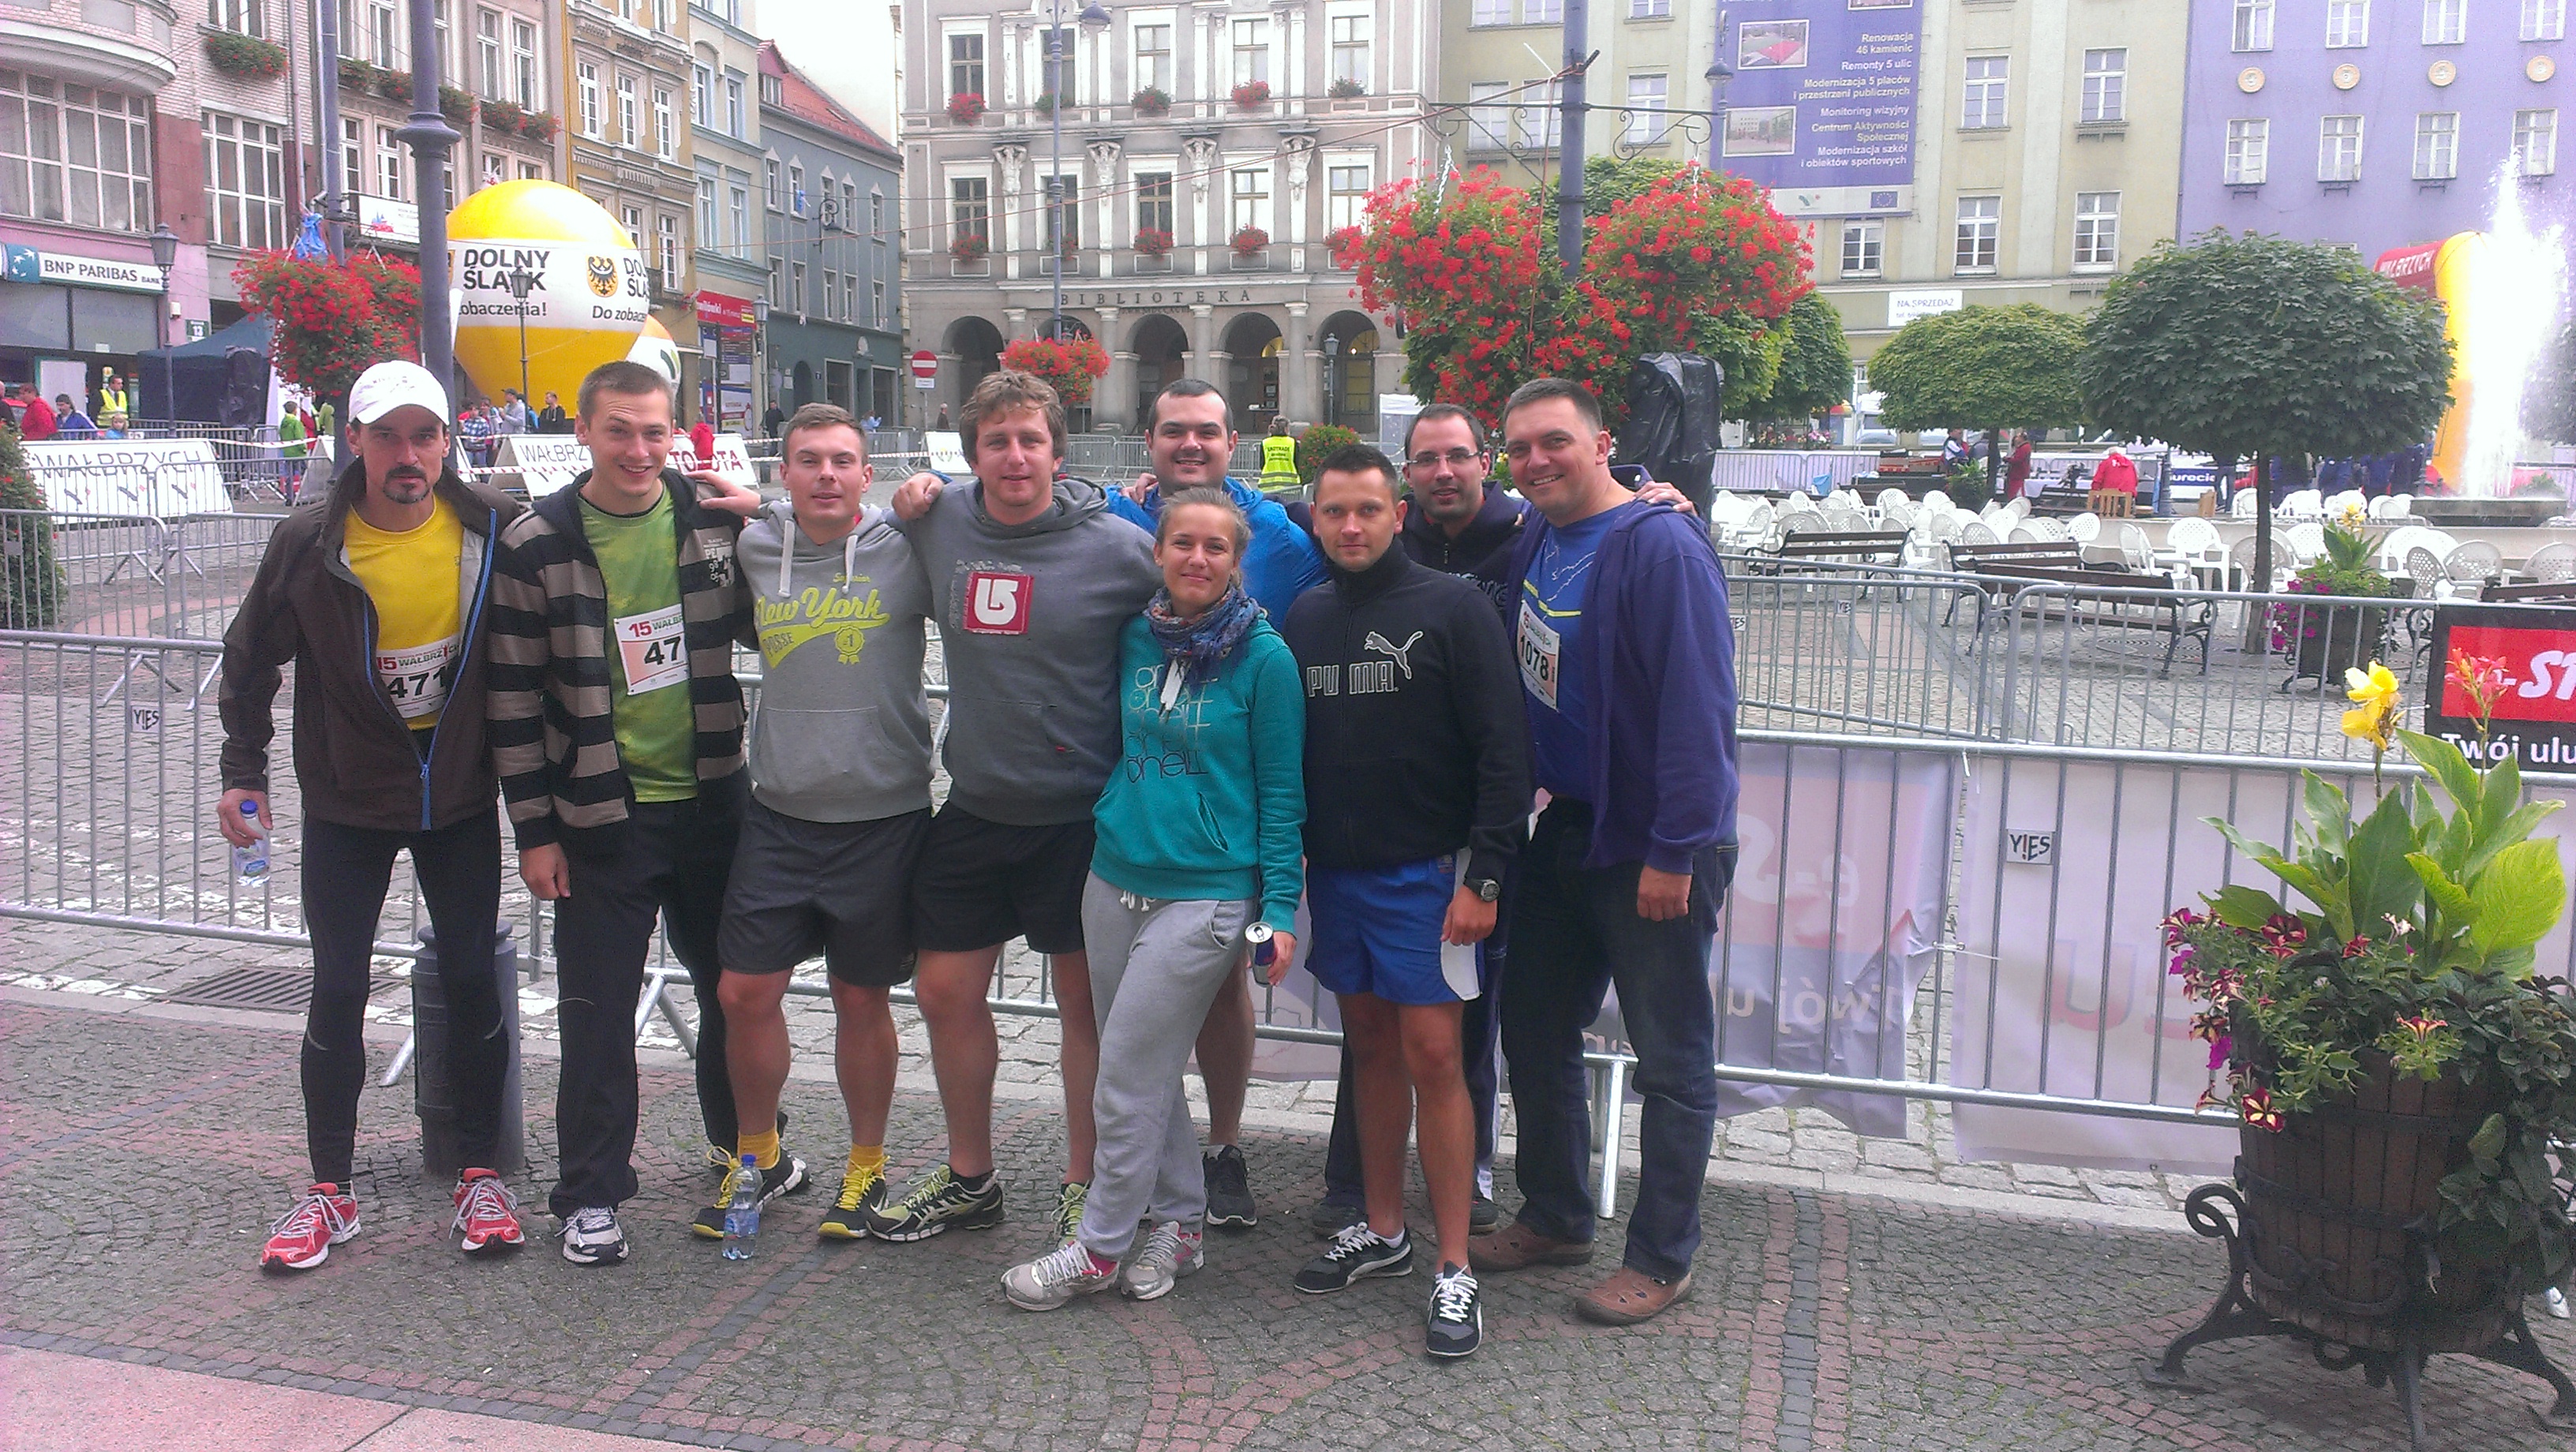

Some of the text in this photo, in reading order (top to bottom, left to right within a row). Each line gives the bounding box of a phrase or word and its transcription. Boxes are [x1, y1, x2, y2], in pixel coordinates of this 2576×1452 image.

[1862, 32, 1914, 43] Renowacja
[1870, 44, 1913, 54] kamienic
[1841, 59, 1912, 71] Remonty 5 ulic
[1804, 75, 1911, 88] Modernizacja 5 placów
[1799, 89, 1851, 101] przestrzeni
[1853, 88, 1910, 99] publicznych
[1820, 106, 1910, 117] Monitoring wizyjny
[1811, 120, 1909, 133] Centrum Aktywności
[1818, 146, 1879, 156] Modernizacja
[1807, 158, 1849, 168] obiektów
[1851, 155, 1907, 167] sportowych
[463, 249, 551, 269] DOLNY
[43, 260, 75, 275] BNP
[79, 264, 138, 282] PARIBAS
[462, 266, 547, 293] ŚLĄK
[1061, 290, 1250, 305] BIBLIOTEKA
[593, 305, 612, 320] Do
[193, 325, 204, 337] 13
[669, 450, 743, 472] TOOTA
[755, 586, 891, 628] New York
[628, 620, 653, 638] 15
[644, 636, 681, 665] 47
[1520, 634, 1548, 681] 1078
[376, 657, 397, 670] 15
[388, 665, 447, 698] 471
[2441, 733, 2522, 763] Twój
